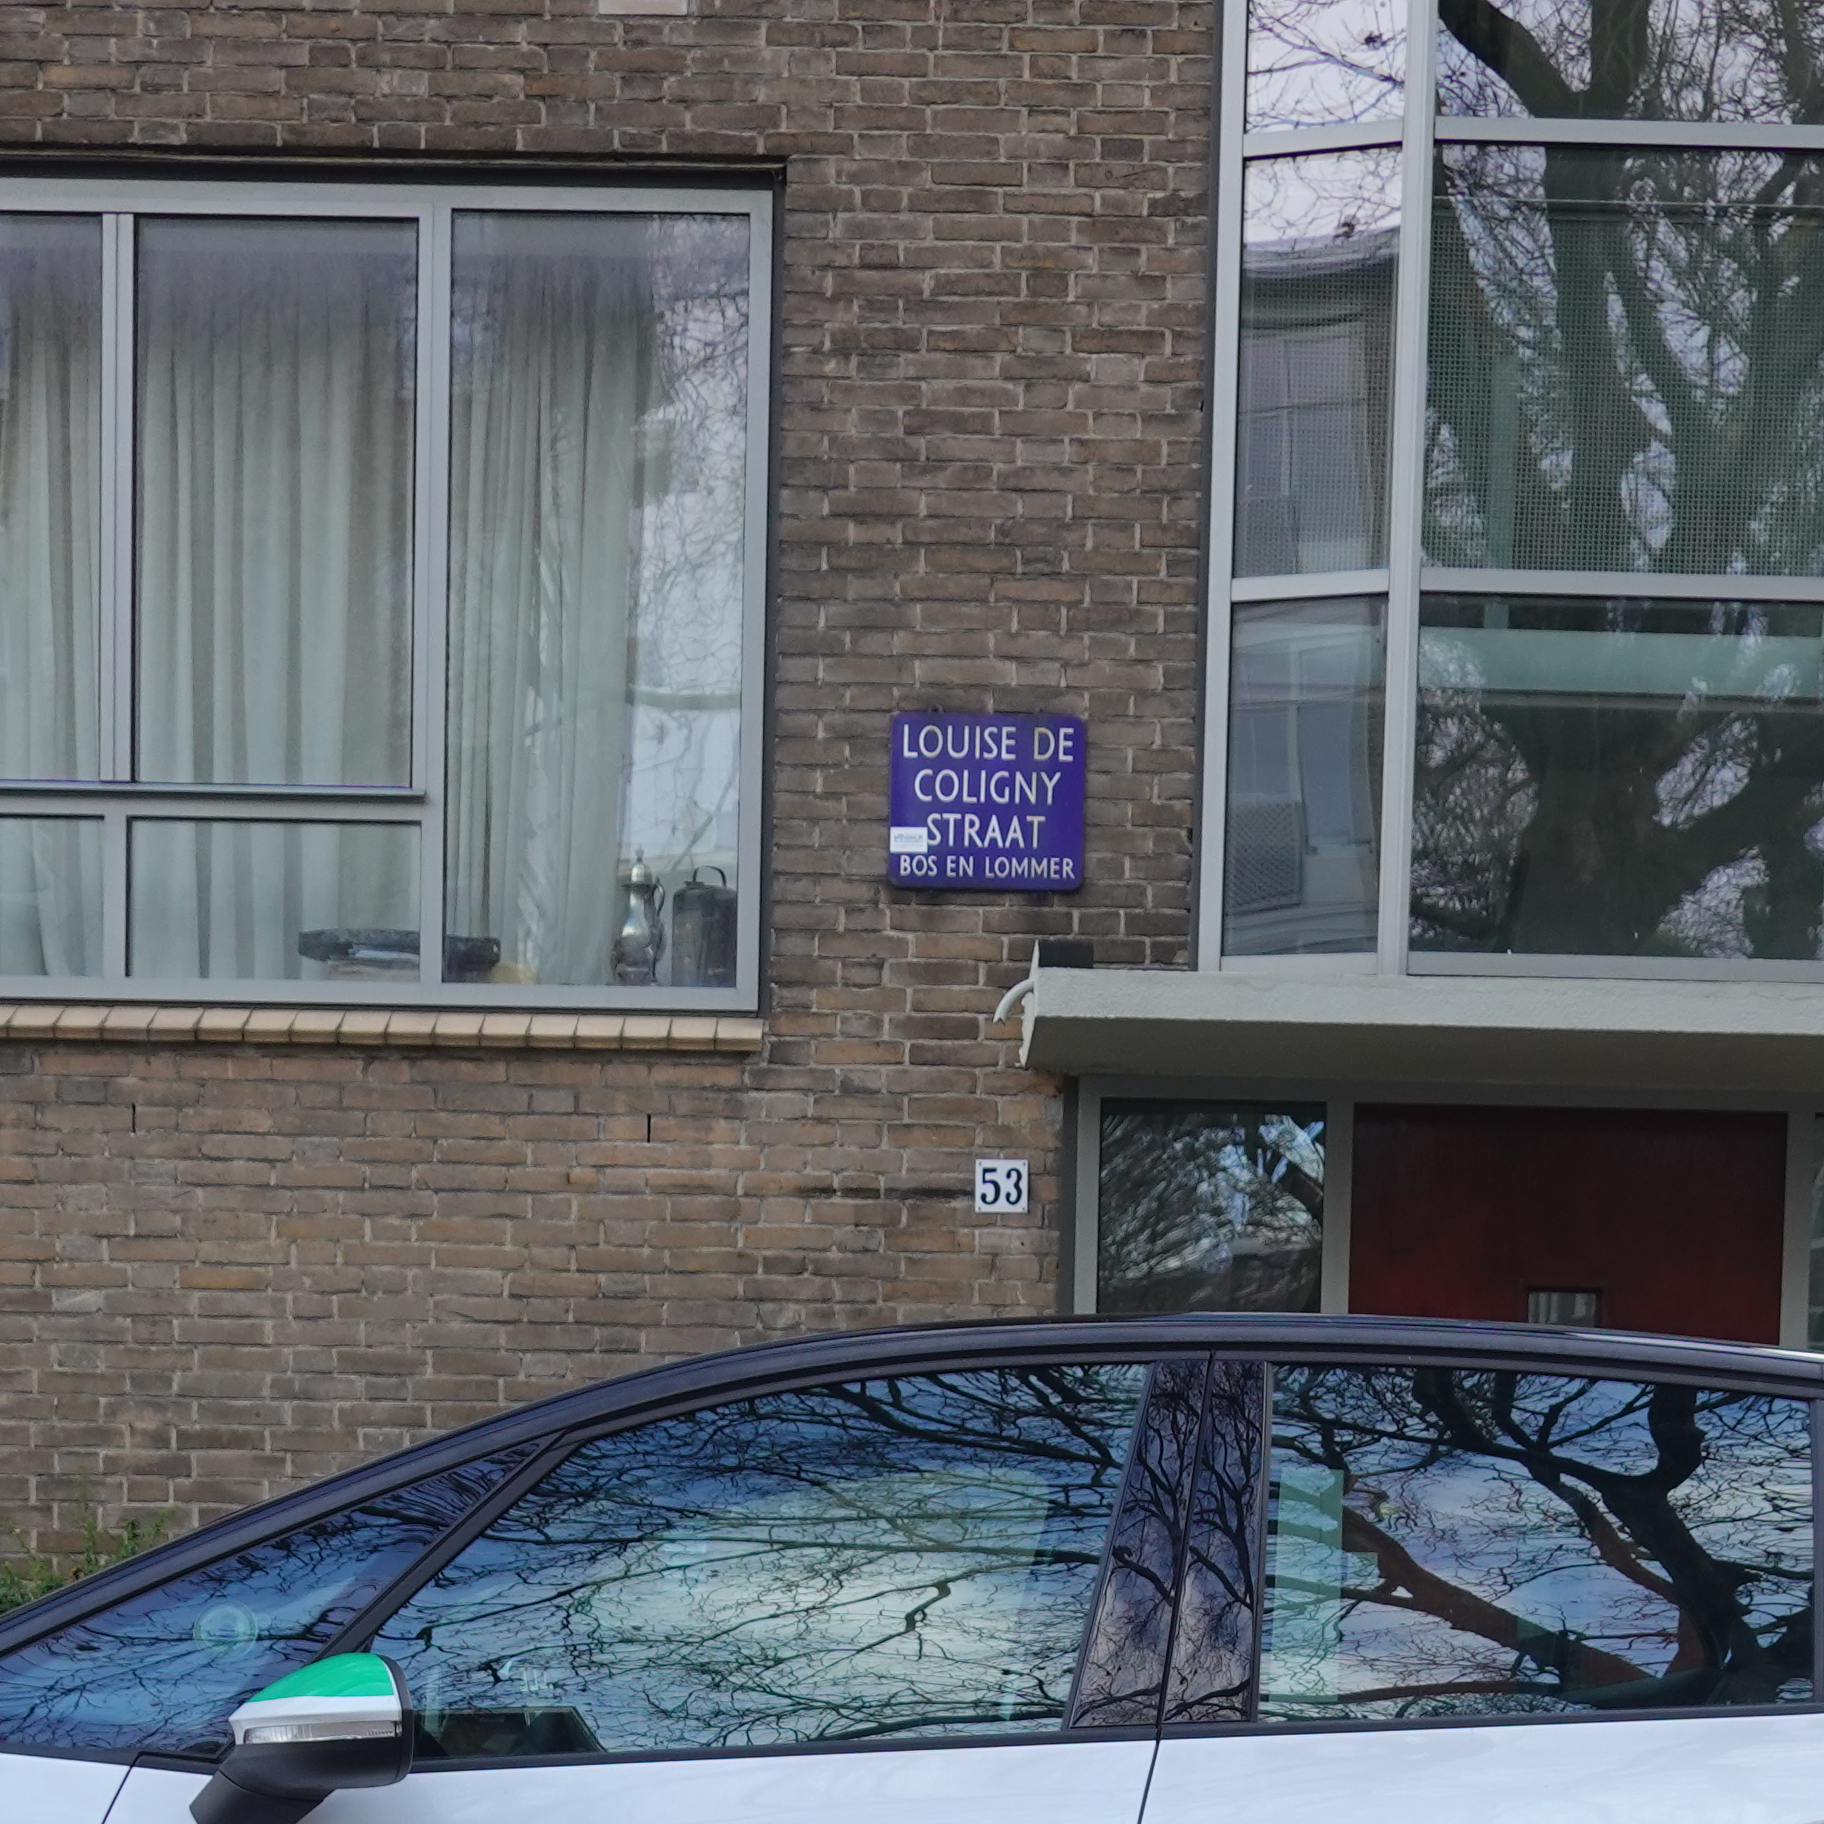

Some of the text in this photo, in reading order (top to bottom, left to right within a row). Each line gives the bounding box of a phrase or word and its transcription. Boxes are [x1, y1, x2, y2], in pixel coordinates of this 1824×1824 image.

[902, 724, 1075, 762] LOUISE DE
[914, 768, 1062, 806] COLIGNY
[926, 812, 1046, 849] STRAAT
[899, 854, 1076, 879] BOS EN LOMMER
[980, 1167, 1023, 1206] 53
